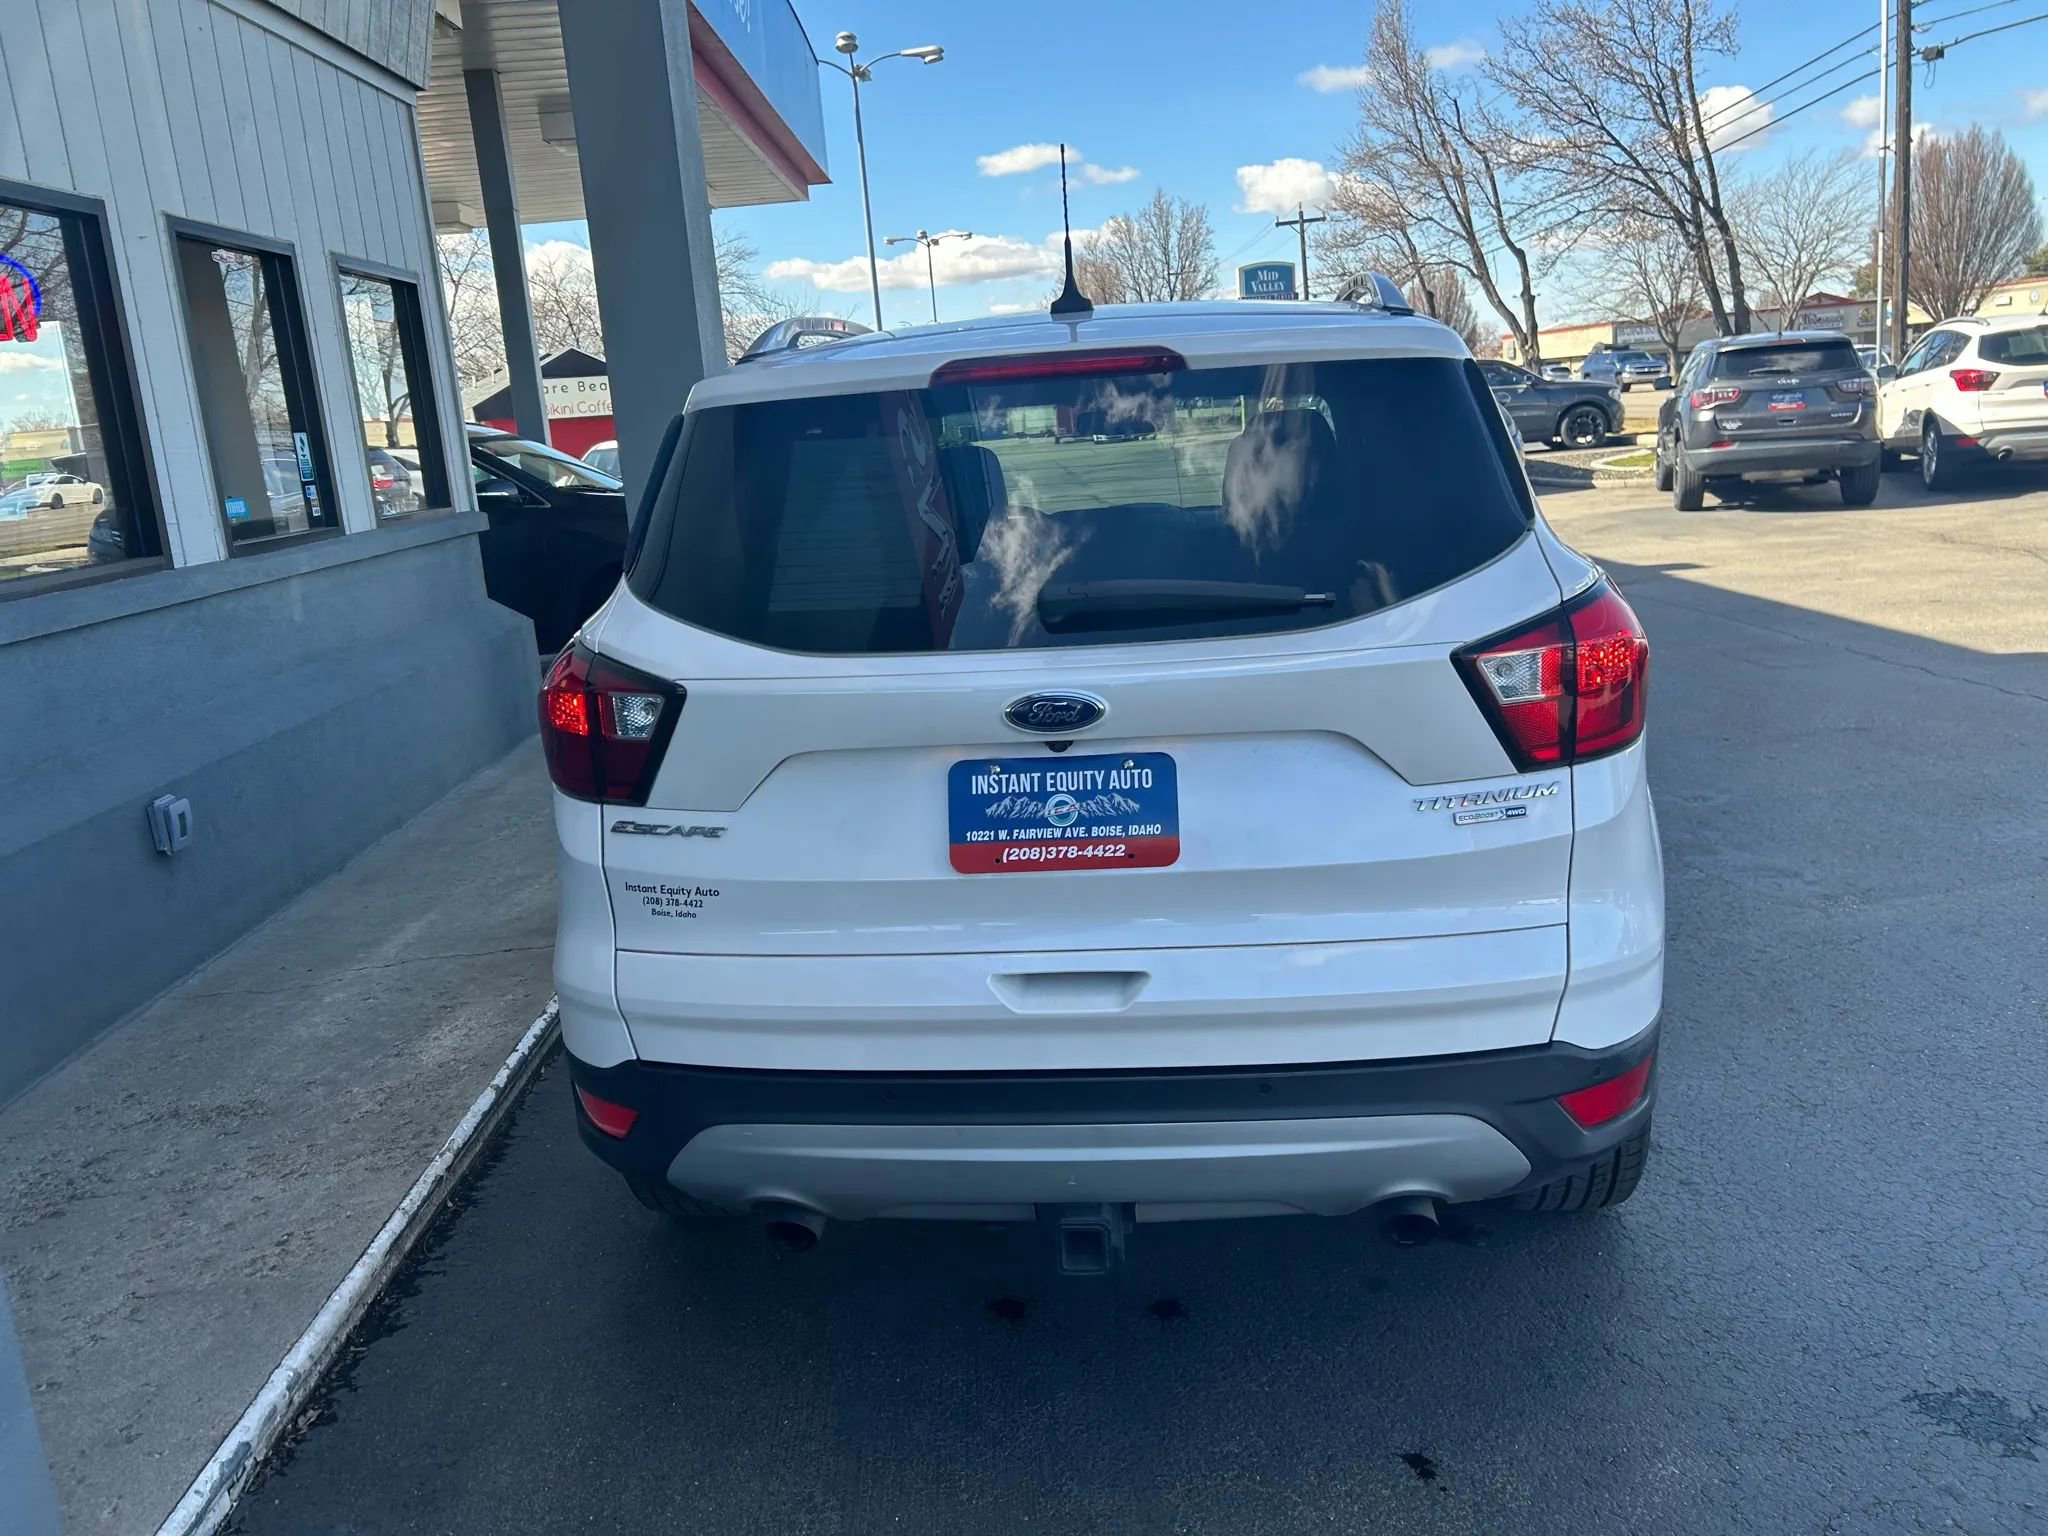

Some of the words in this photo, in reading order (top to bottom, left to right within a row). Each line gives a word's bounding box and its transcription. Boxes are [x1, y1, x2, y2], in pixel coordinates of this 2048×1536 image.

[1251, 281, 1286, 293] VALLEY
[1028, 701, 1081, 724] Ford
[971, 772, 1041, 795] INSTANT
[1046, 769, 1105, 792] EQUITY
[1109, 768, 1153, 790] AUTO
[1413, 780, 1561, 811] TITANIUM
[1506, 808, 1525, 816] 4WD
[610, 820, 729, 839] ESCAPE
[966, 830, 995, 842] 10221
[998, 829, 1010, 841] W.
[1012, 827, 1063, 840] FAIRVIEW
[1064, 826, 1089, 838] AVE.
[1091, 825, 1126, 838] BOISE,
[1128, 823, 1162, 836] IDAHO
[1002, 843, 1126, 864] (208)378-4422
[625, 882, 657, 894] Instant
[660, 884, 691, 898] Equity
[694, 886, 720, 897] Auto
[642, 896, 663, 908] (208)
[665, 897, 704, 908] 378-4422
[651, 908, 674, 918] Boise,
[675, 909, 697, 919] Idaho
